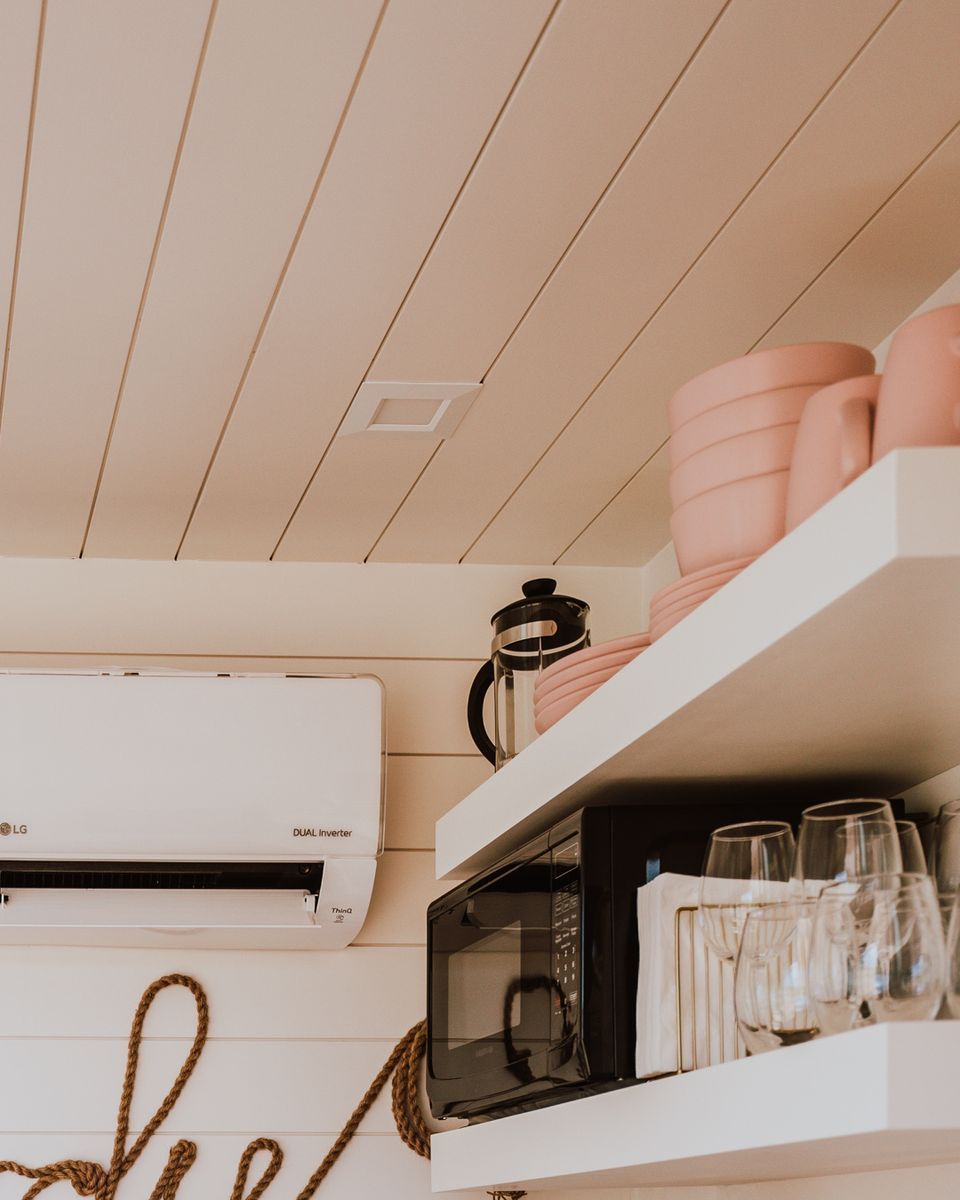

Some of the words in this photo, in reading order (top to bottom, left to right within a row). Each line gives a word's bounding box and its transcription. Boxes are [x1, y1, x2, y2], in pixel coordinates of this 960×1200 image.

[12, 824, 28, 834] LG
[293, 828, 317, 837] DUAL
[318, 828, 353, 837] Inverter
